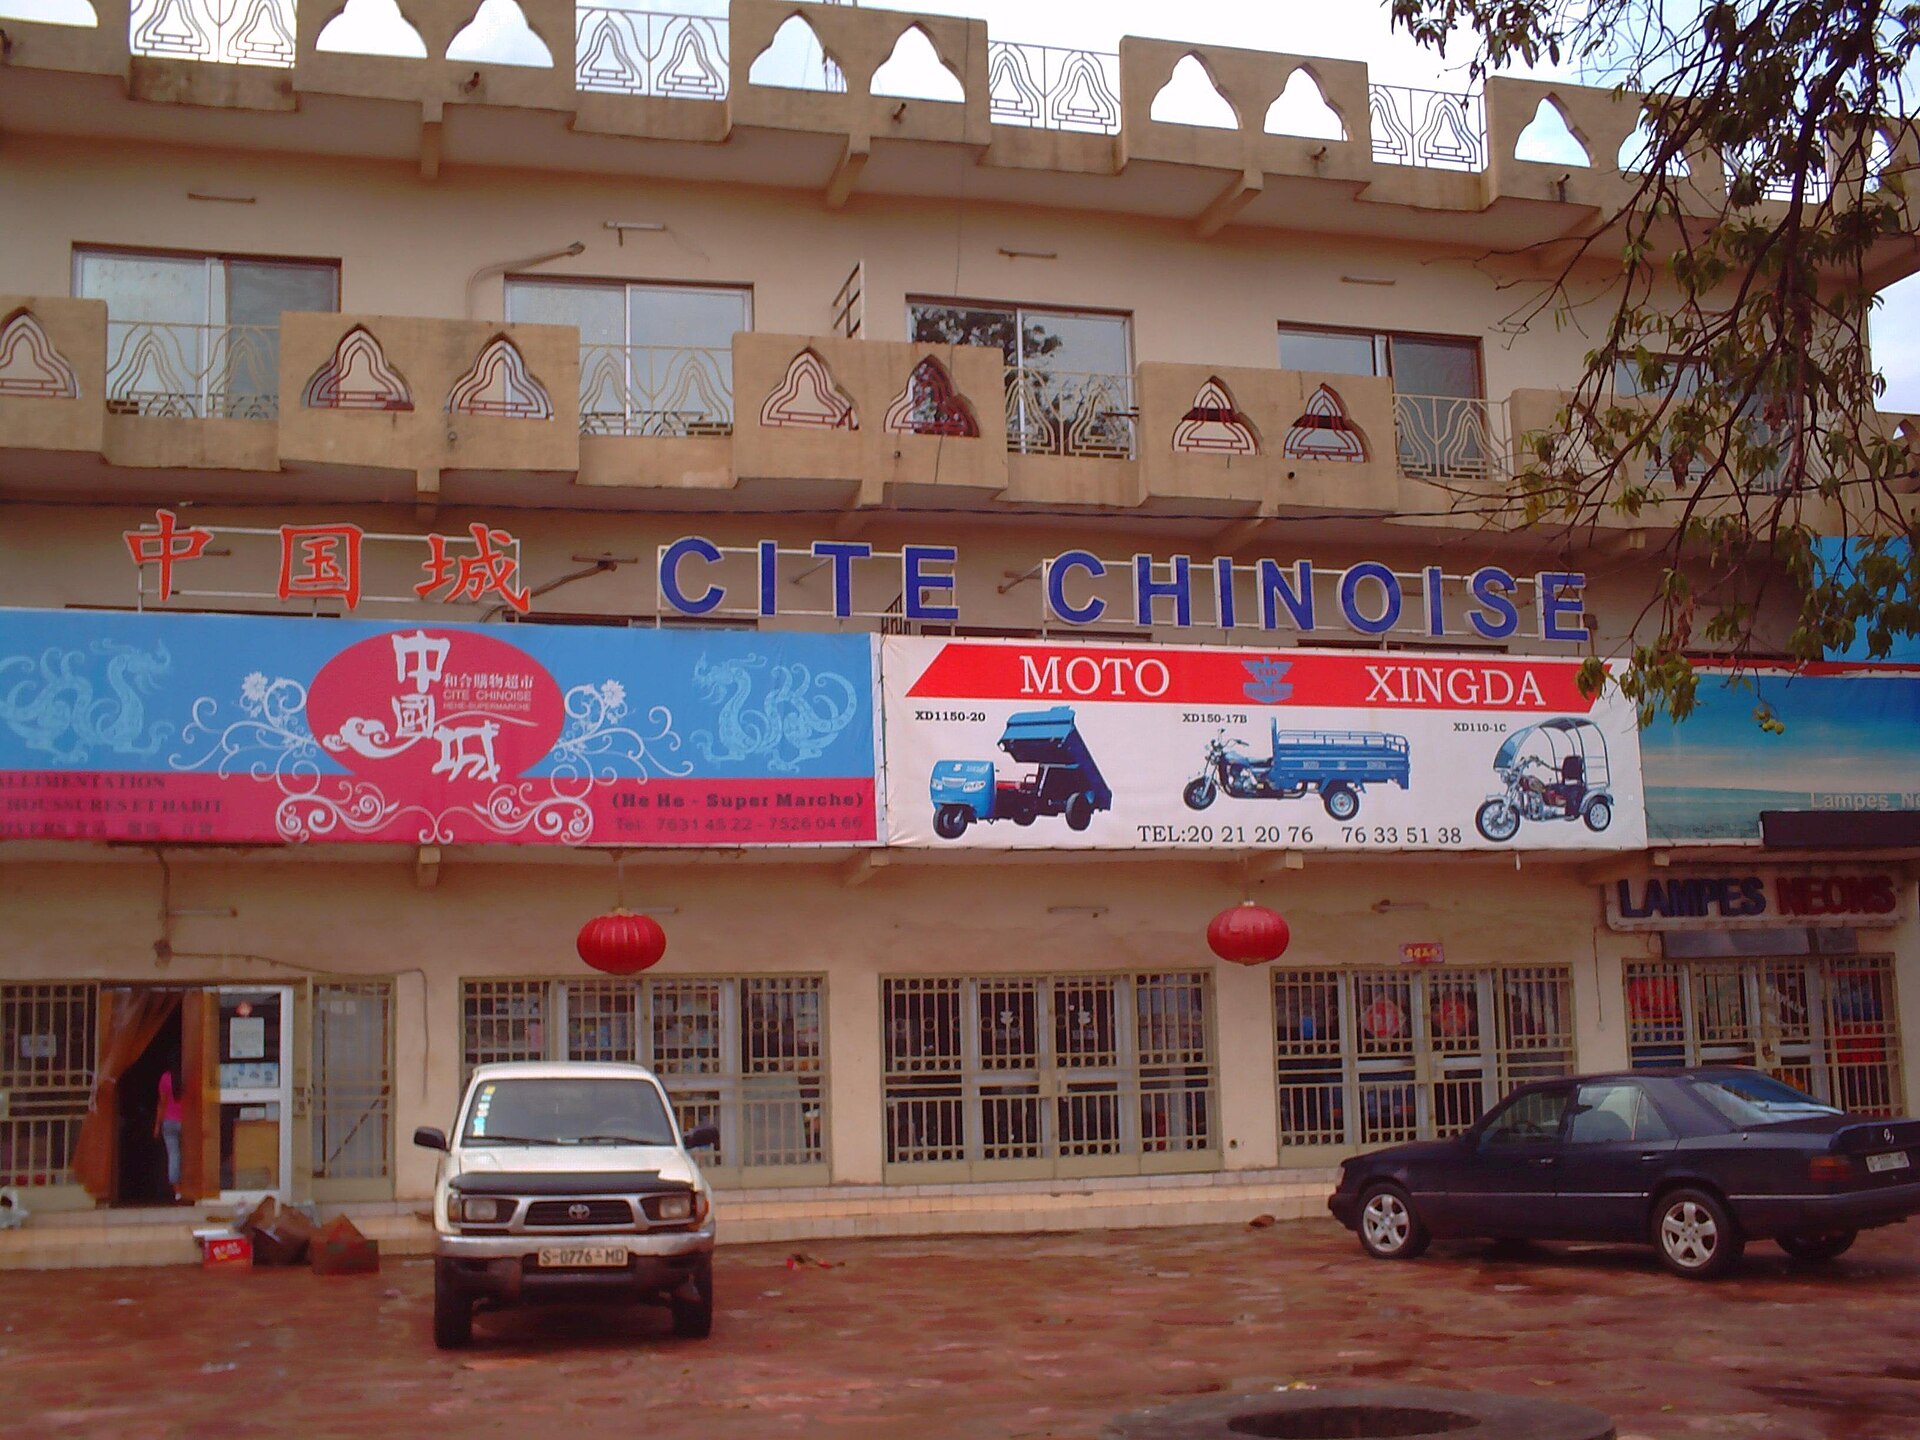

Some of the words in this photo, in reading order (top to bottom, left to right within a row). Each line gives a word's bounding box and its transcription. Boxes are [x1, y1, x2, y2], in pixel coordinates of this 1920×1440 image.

[123, 508, 531, 613] 中国城
[658, 536, 960, 621] CITE
[1045, 549, 1590, 642] CHINOISE
[1019, 655, 1170, 696] MOTO
[1365, 666, 1546, 706] XINGDA
[443, 689, 470, 701] CITE
[476, 690, 532, 702] CHINOISE
[915, 710, 986, 722] XD1150-20
[1182, 713, 1248, 724] XD150-17B
[1453, 722, 1507, 732] XD110-1C
[657, 793, 685, 808] He
[706, 793, 769, 811] Super
[776, 793, 864, 809] Marche)
[1810, 792, 1889, 811] Lampes
[1137, 825, 1213, 842] TEL:20
[1221, 826, 1245, 842] 21
[1255, 826, 1281, 842] 20
[1288, 826, 1314, 842] 76
[1342, 826, 1367, 843] 76
[1374, 827, 1399, 843] 33
[1406, 827, 1429, 843] 51
[1438, 827, 1462, 844] 38
[1617, 877, 1767, 918] LAMPES
[1776, 875, 1897, 916] NEONS
